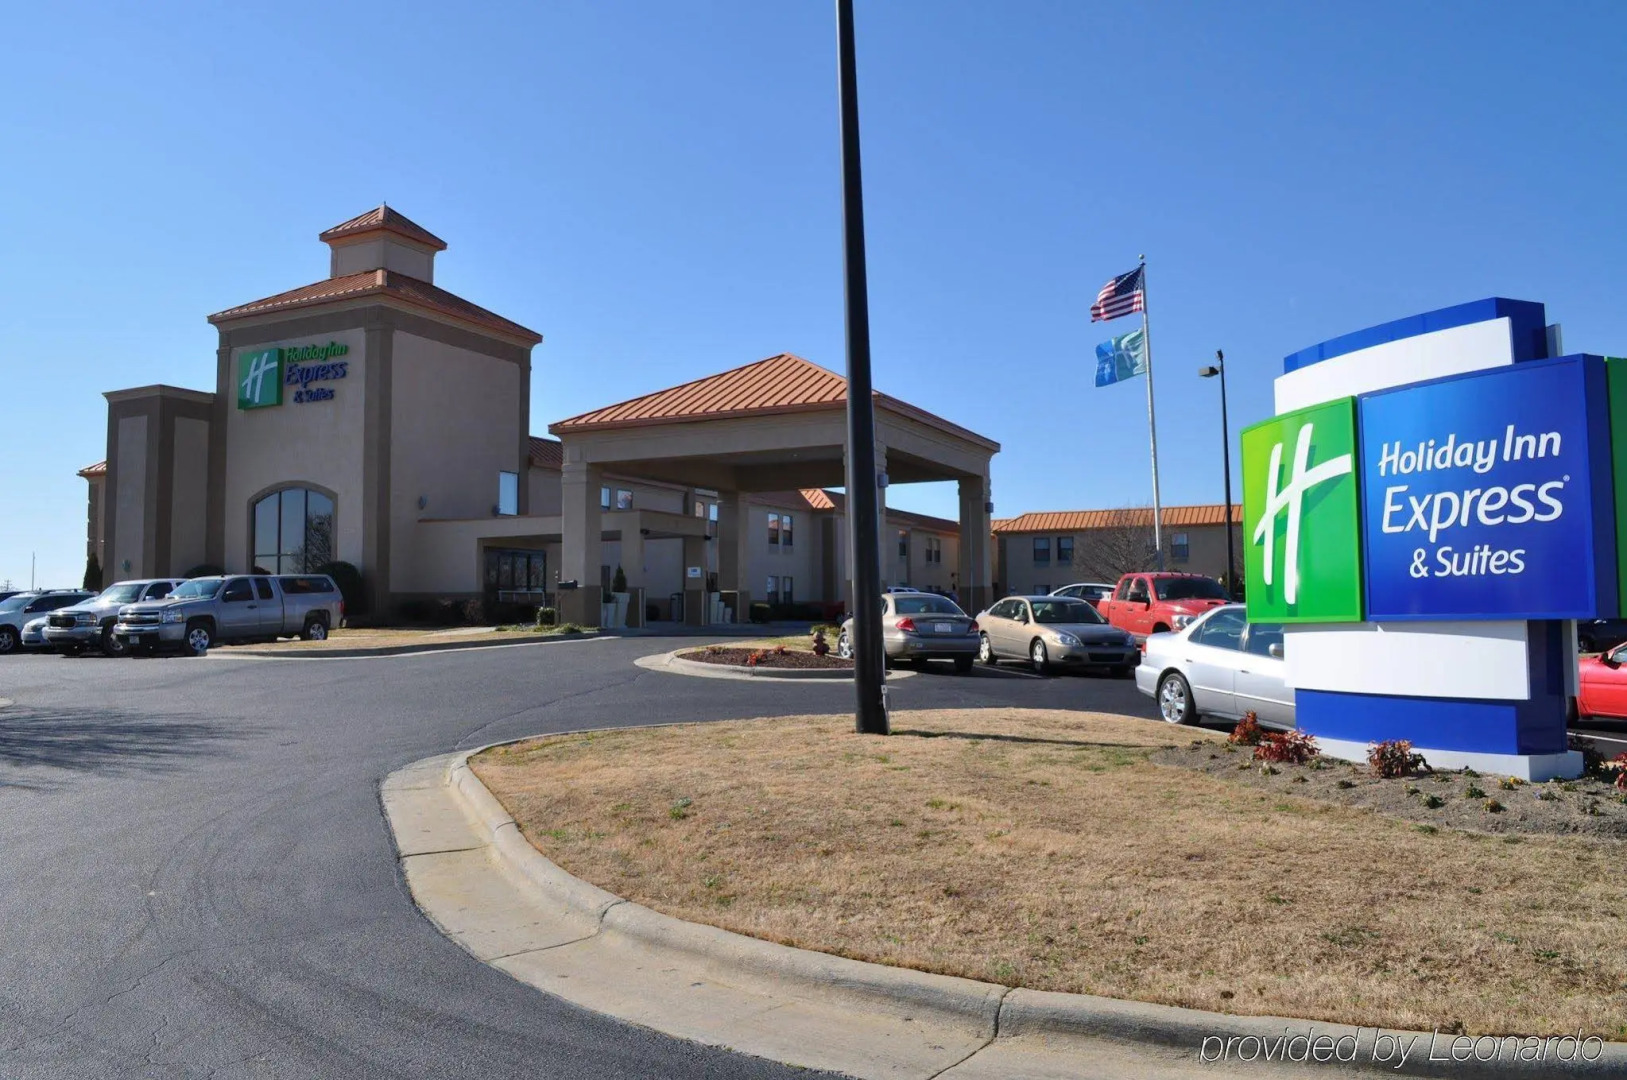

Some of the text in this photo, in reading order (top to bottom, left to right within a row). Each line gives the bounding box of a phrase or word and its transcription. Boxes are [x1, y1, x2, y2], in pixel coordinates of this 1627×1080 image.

[286, 341, 348, 363] Holiday Inn
[285, 363, 348, 388] Express
[294, 388, 335, 403] & Suites
[1378, 425, 1562, 476] Holiday Inn
[1409, 545, 1526, 578] & Suites
